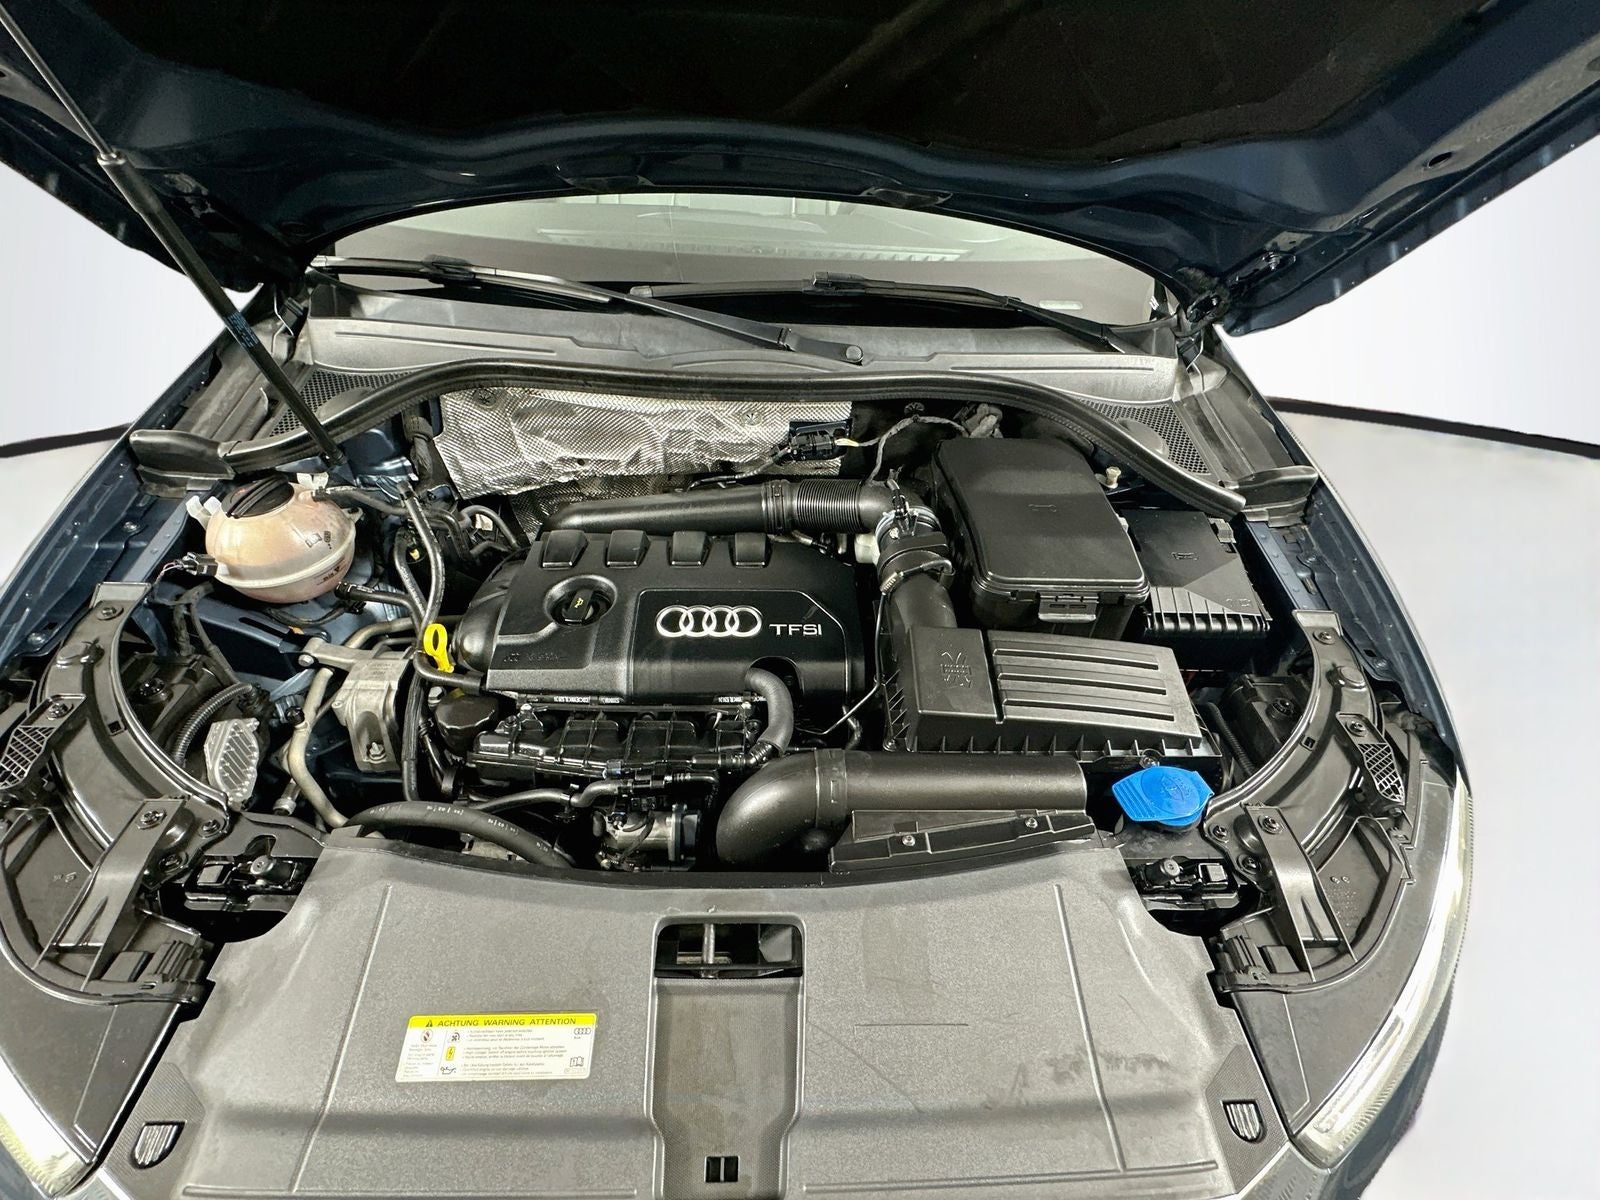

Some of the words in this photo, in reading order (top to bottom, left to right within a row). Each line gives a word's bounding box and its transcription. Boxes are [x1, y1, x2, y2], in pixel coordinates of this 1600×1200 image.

[769, 623, 823, 636] TFSI
[437, 1019, 479, 1027] ACHTUNG
[483, 1018, 526, 1026] WARNING
